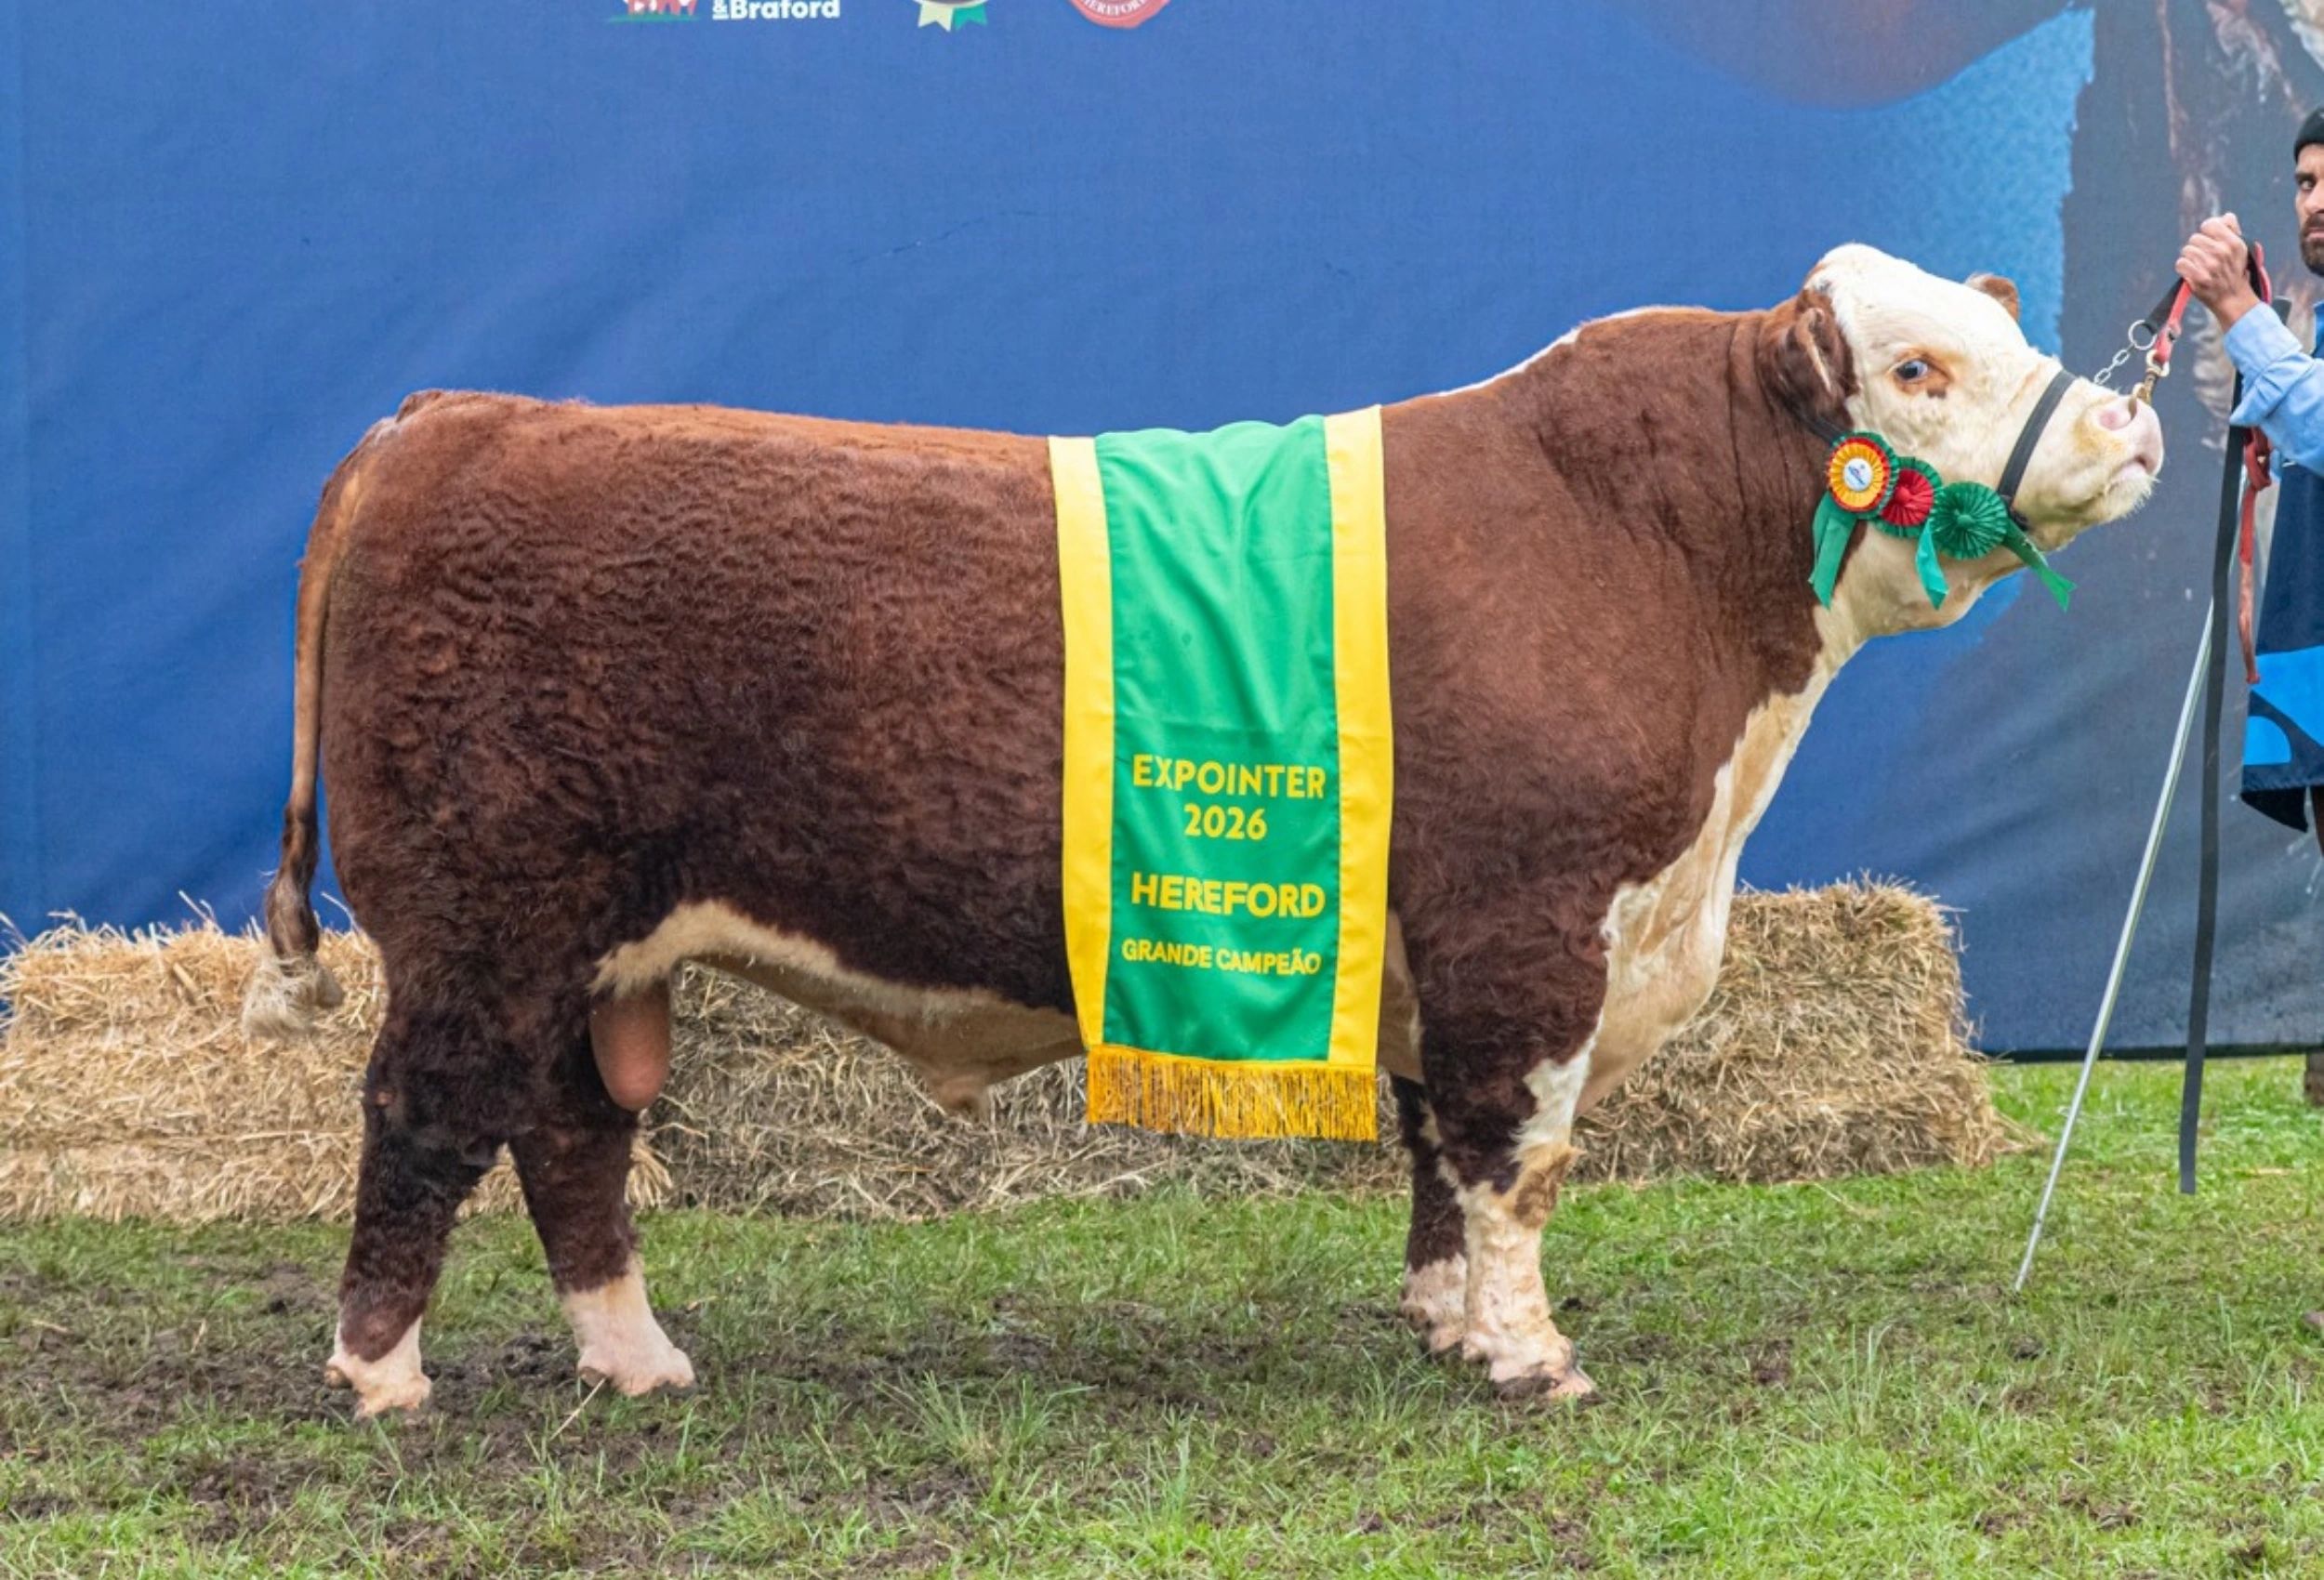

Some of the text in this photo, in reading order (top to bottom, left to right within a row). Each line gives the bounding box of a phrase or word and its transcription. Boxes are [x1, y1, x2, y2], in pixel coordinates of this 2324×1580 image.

[1132, 754, 1327, 798] EXPOINTER
[1184, 803, 1267, 840] 2026
[1131, 872, 1326, 918] HEREFORD
[1121, 938, 1322, 975] GRANDE CAMPEÃO
